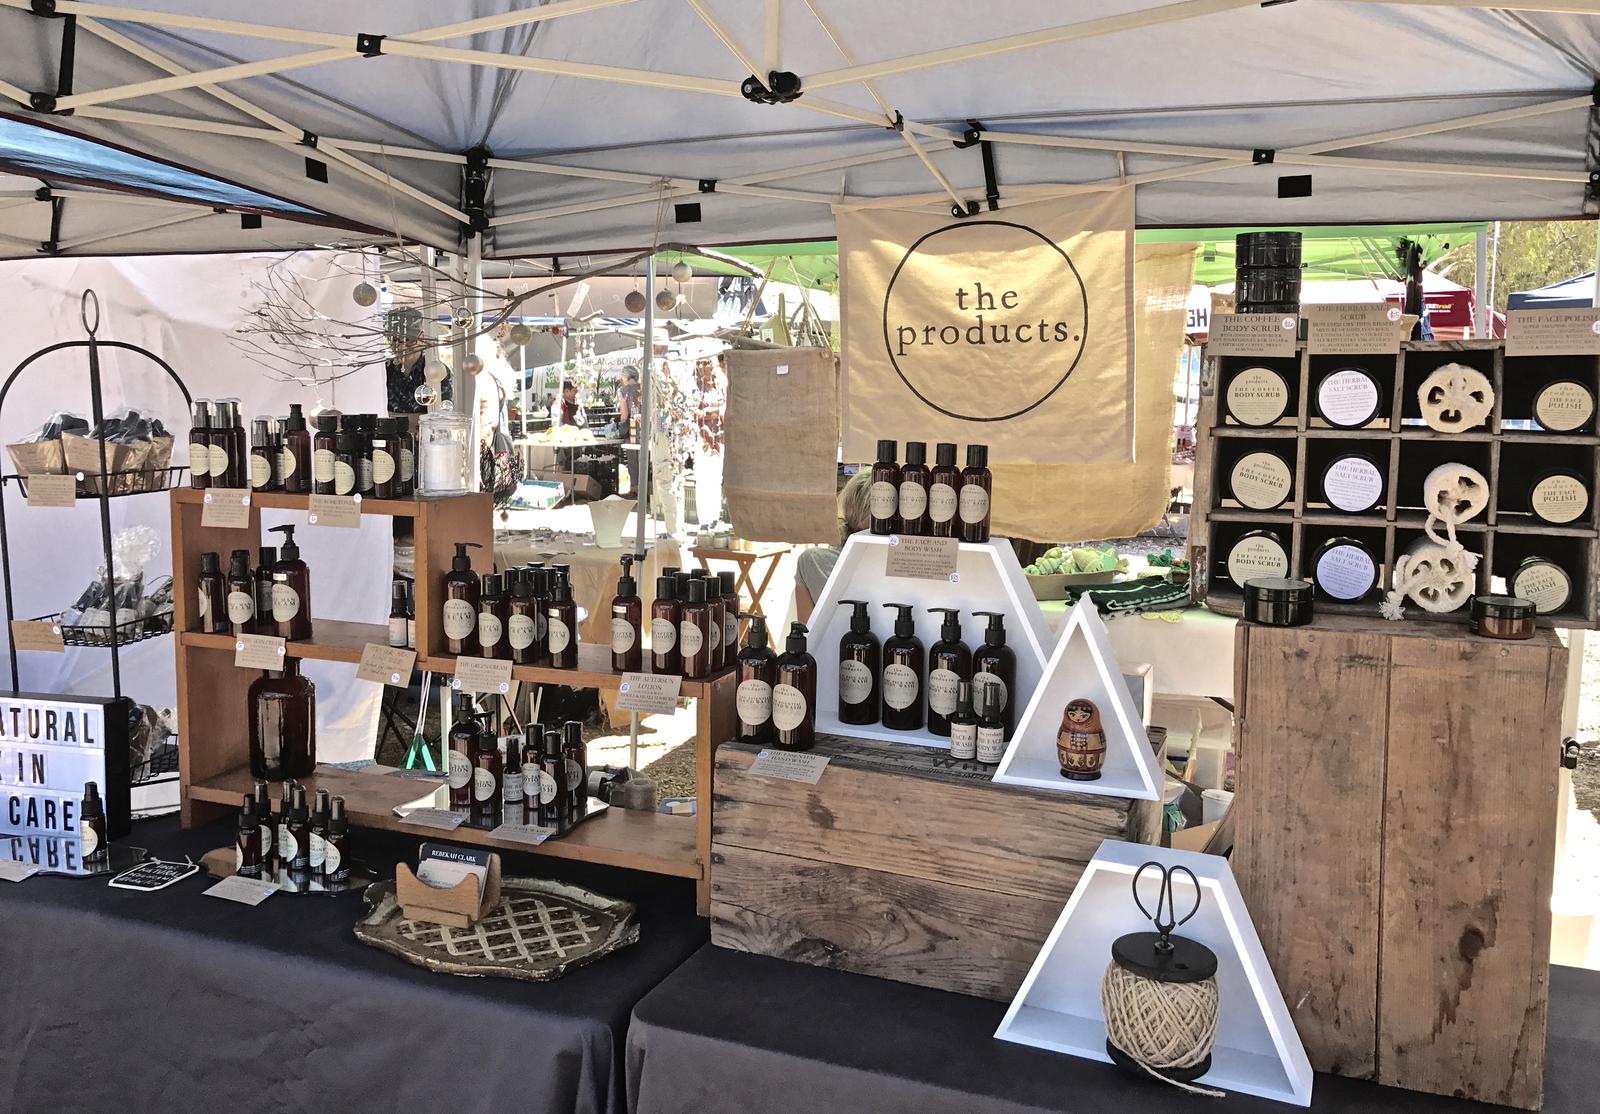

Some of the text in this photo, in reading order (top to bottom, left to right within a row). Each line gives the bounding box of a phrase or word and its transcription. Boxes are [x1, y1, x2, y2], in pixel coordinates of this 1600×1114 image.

[955, 282, 1019, 310] the
[1224, 315, 1243, 323] THE
[1246, 315, 1281, 323] COFFEE
[896, 315, 1080, 356] products.
[1239, 471, 1283, 489] BODY SCRUB
[1257, 560, 1281, 568] SCRUB
[1523, 582, 1536, 591] THE
[1525, 581, 1557, 596] POLISH
[9, 796, 75, 831] CARE
[431, 849, 457, 860] REBEKAH
